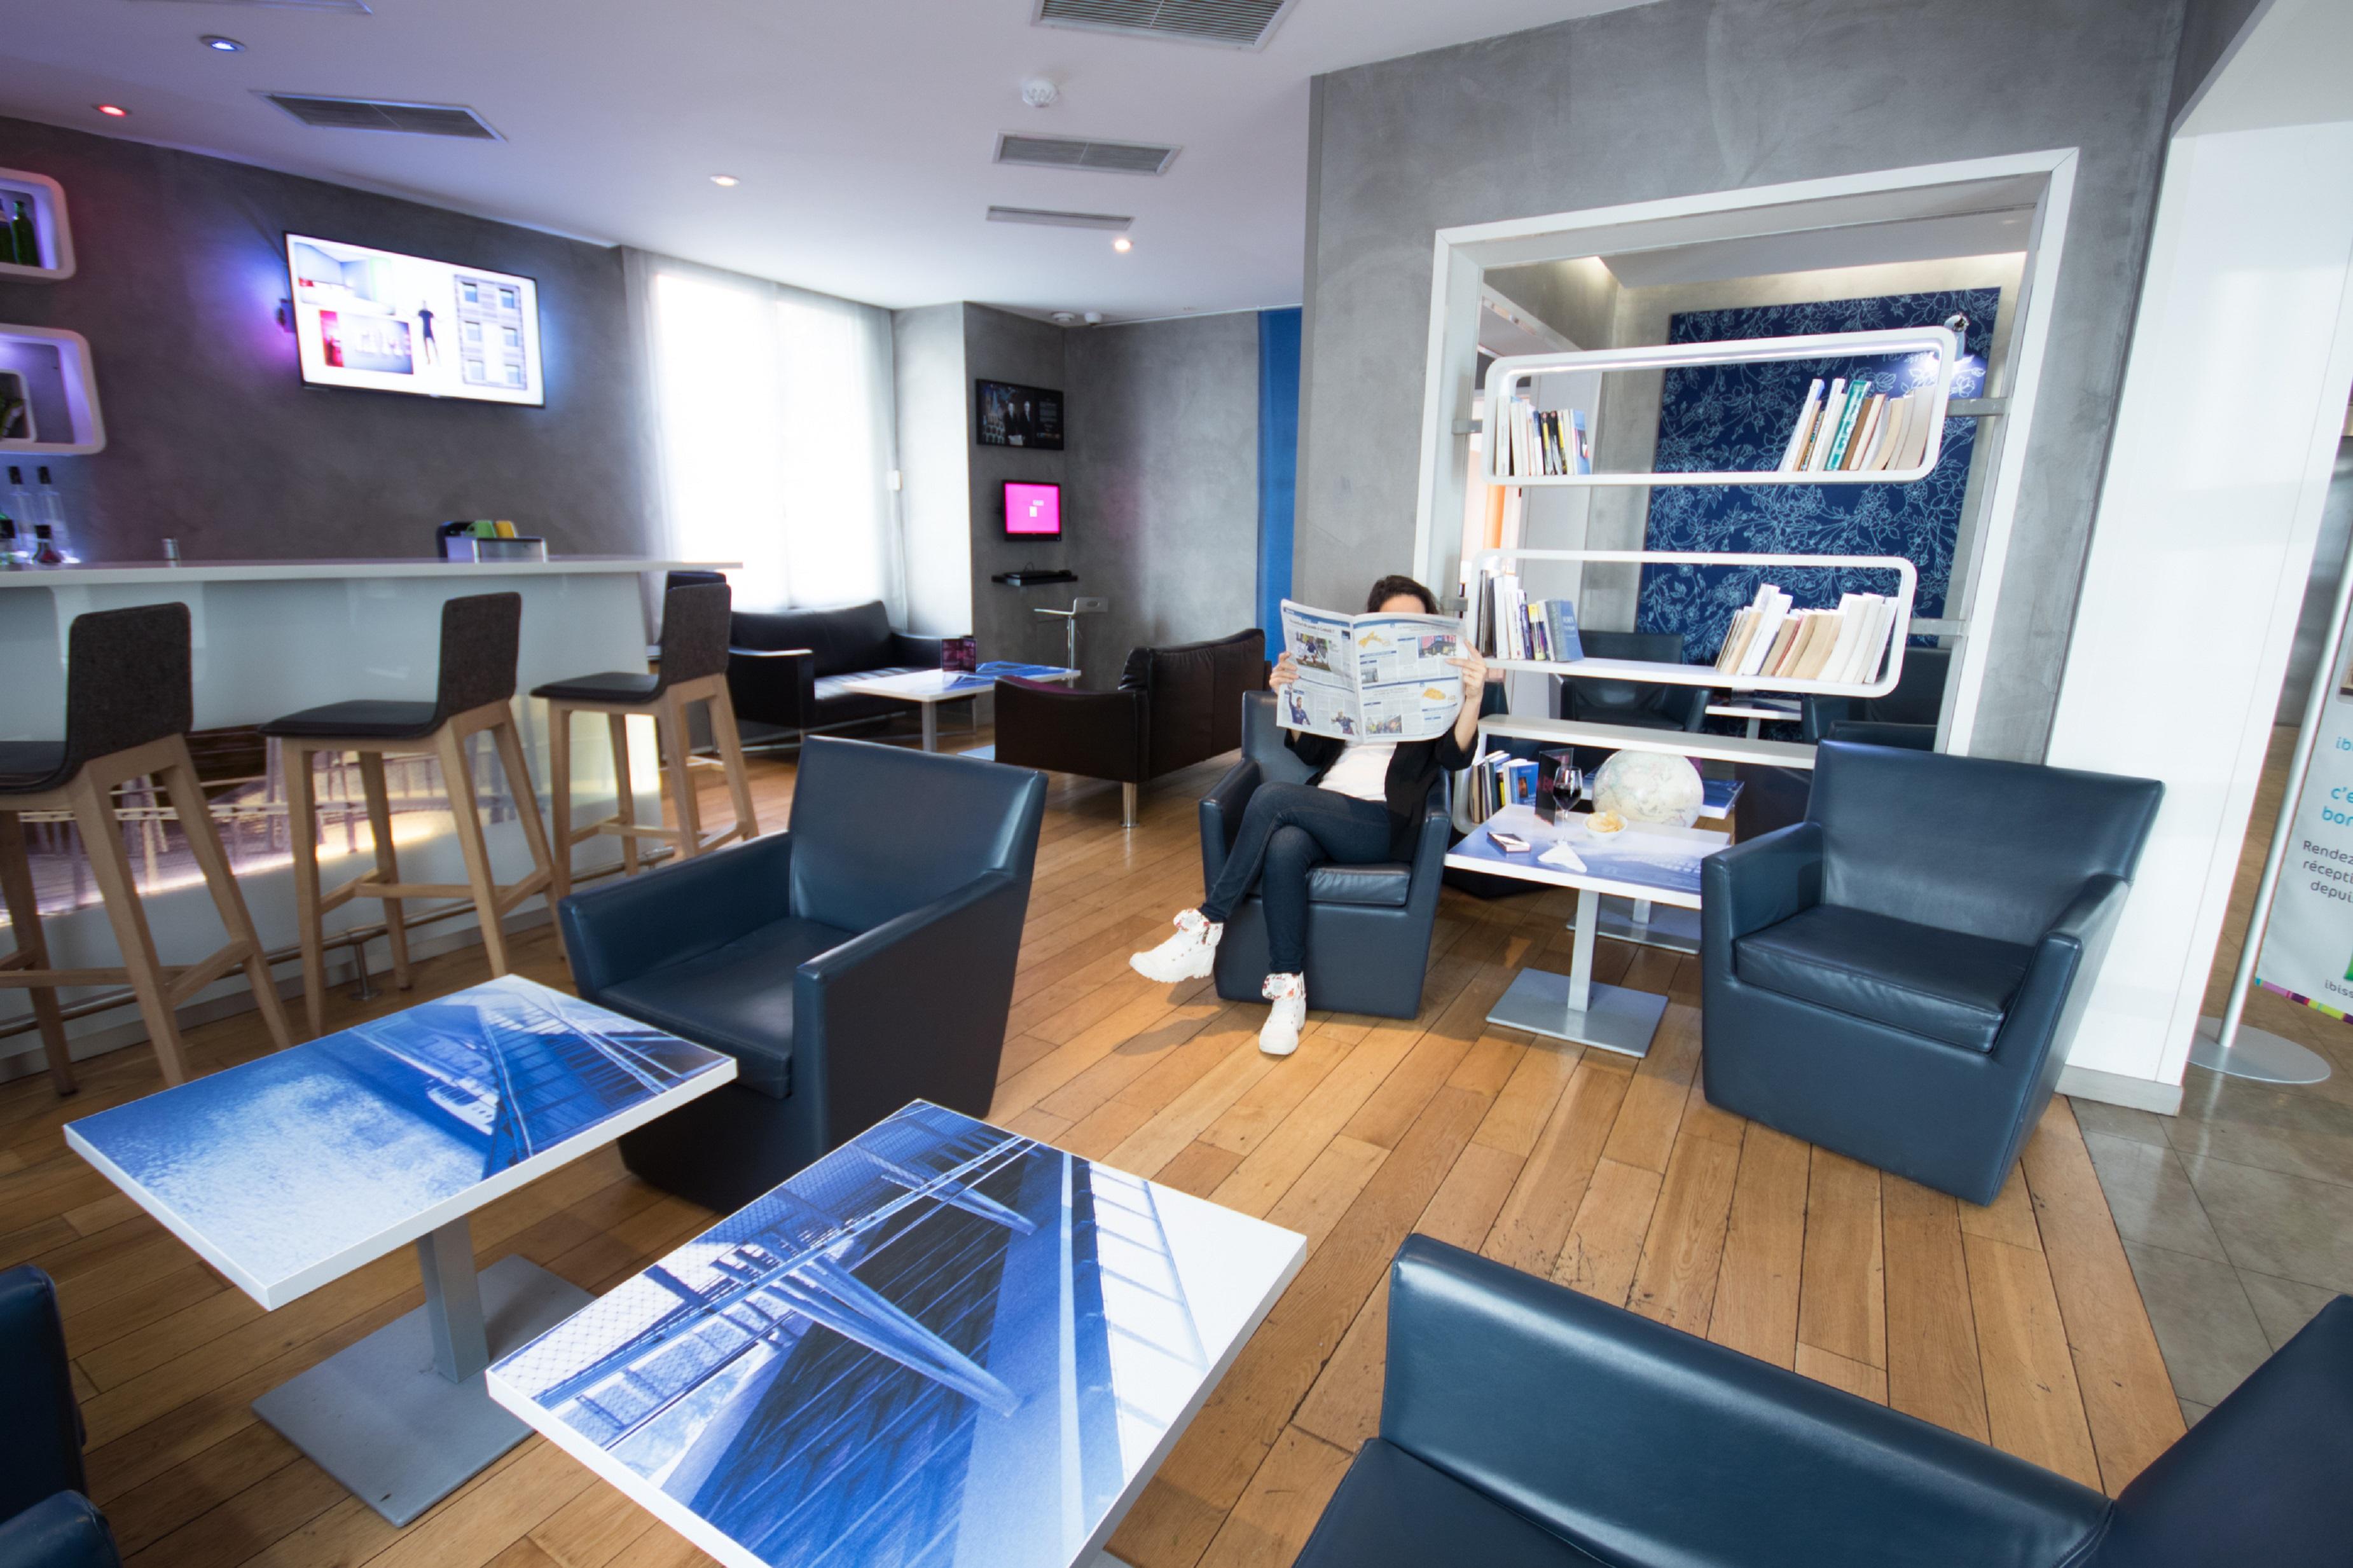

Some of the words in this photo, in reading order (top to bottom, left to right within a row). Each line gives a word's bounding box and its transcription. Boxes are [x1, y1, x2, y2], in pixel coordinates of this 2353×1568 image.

[2336, 736, 2353, 752] ib
[2303, 840, 2353, 865] Rendez
[2303, 860, 2353, 884] récepti
